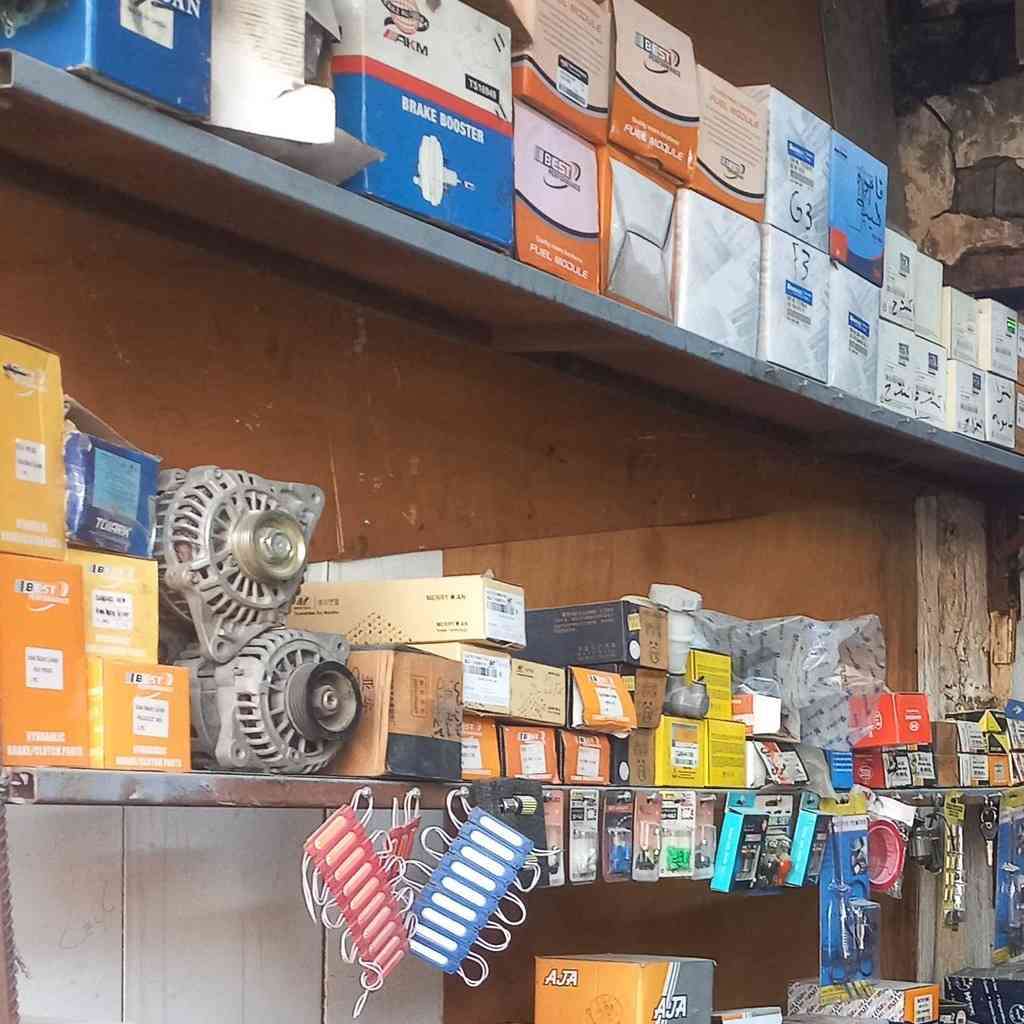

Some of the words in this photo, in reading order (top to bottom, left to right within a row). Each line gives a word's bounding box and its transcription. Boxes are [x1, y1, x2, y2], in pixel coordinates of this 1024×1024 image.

[401, 95, 438, 123] BRAKE
[439, 111, 485, 144] BOOSTER
[649, 136, 684, 161] MODULE
[529, 243, 553, 261] FUEL
[554, 255, 589, 279] MODULE
[544, 968, 579, 987] AJA
[653, 994, 688, 1020] AJA
